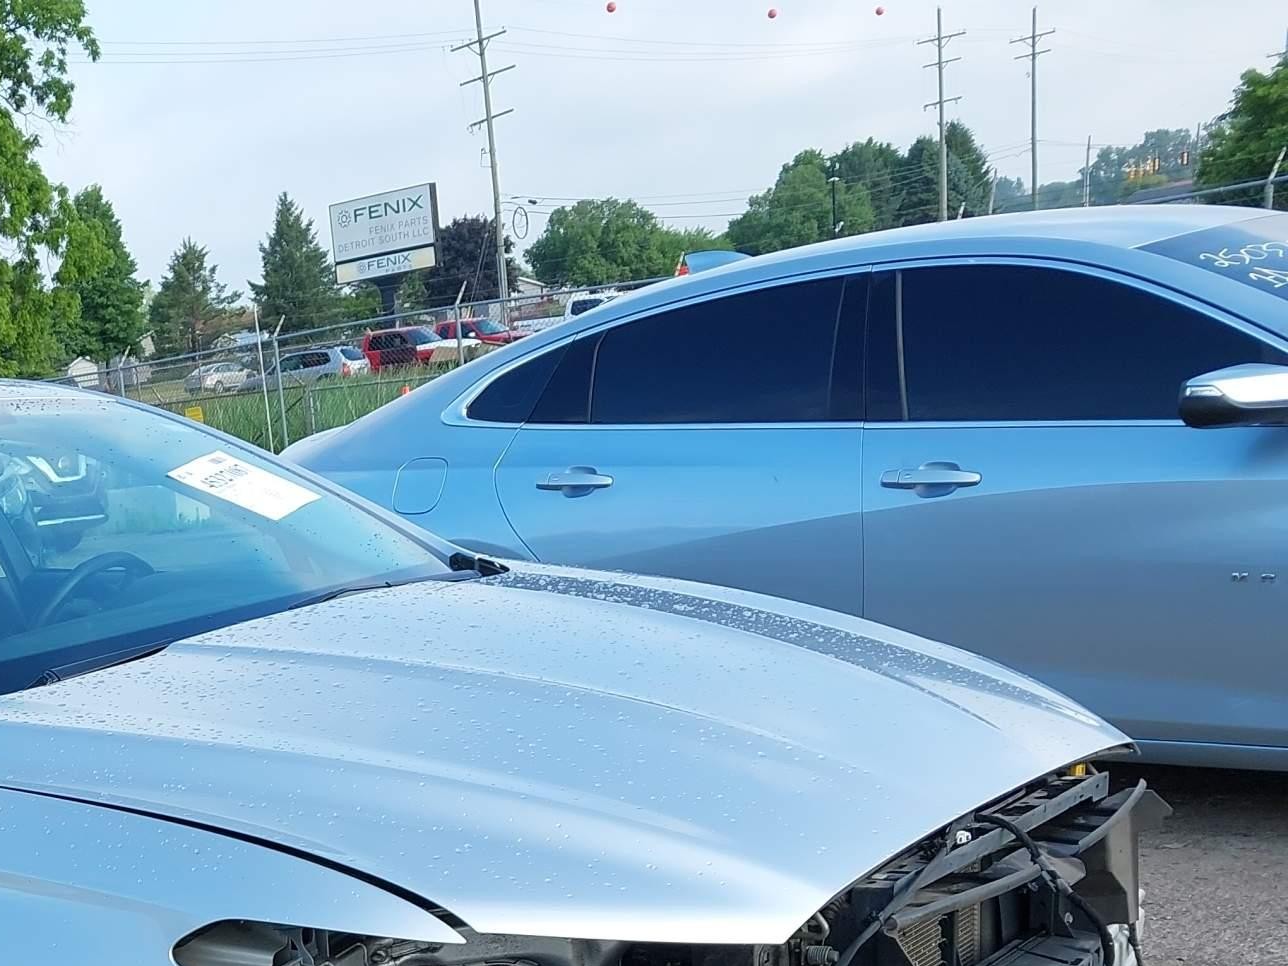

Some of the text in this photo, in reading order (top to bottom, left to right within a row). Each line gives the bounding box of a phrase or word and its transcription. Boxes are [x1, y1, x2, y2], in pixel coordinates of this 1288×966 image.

[353, 194, 424, 223] FENIX
[368, 215, 428, 235] FENIX PARTS
[338, 226, 430, 253] DETROIT SOUTH LLC
[367, 253, 412, 271] FENIX
